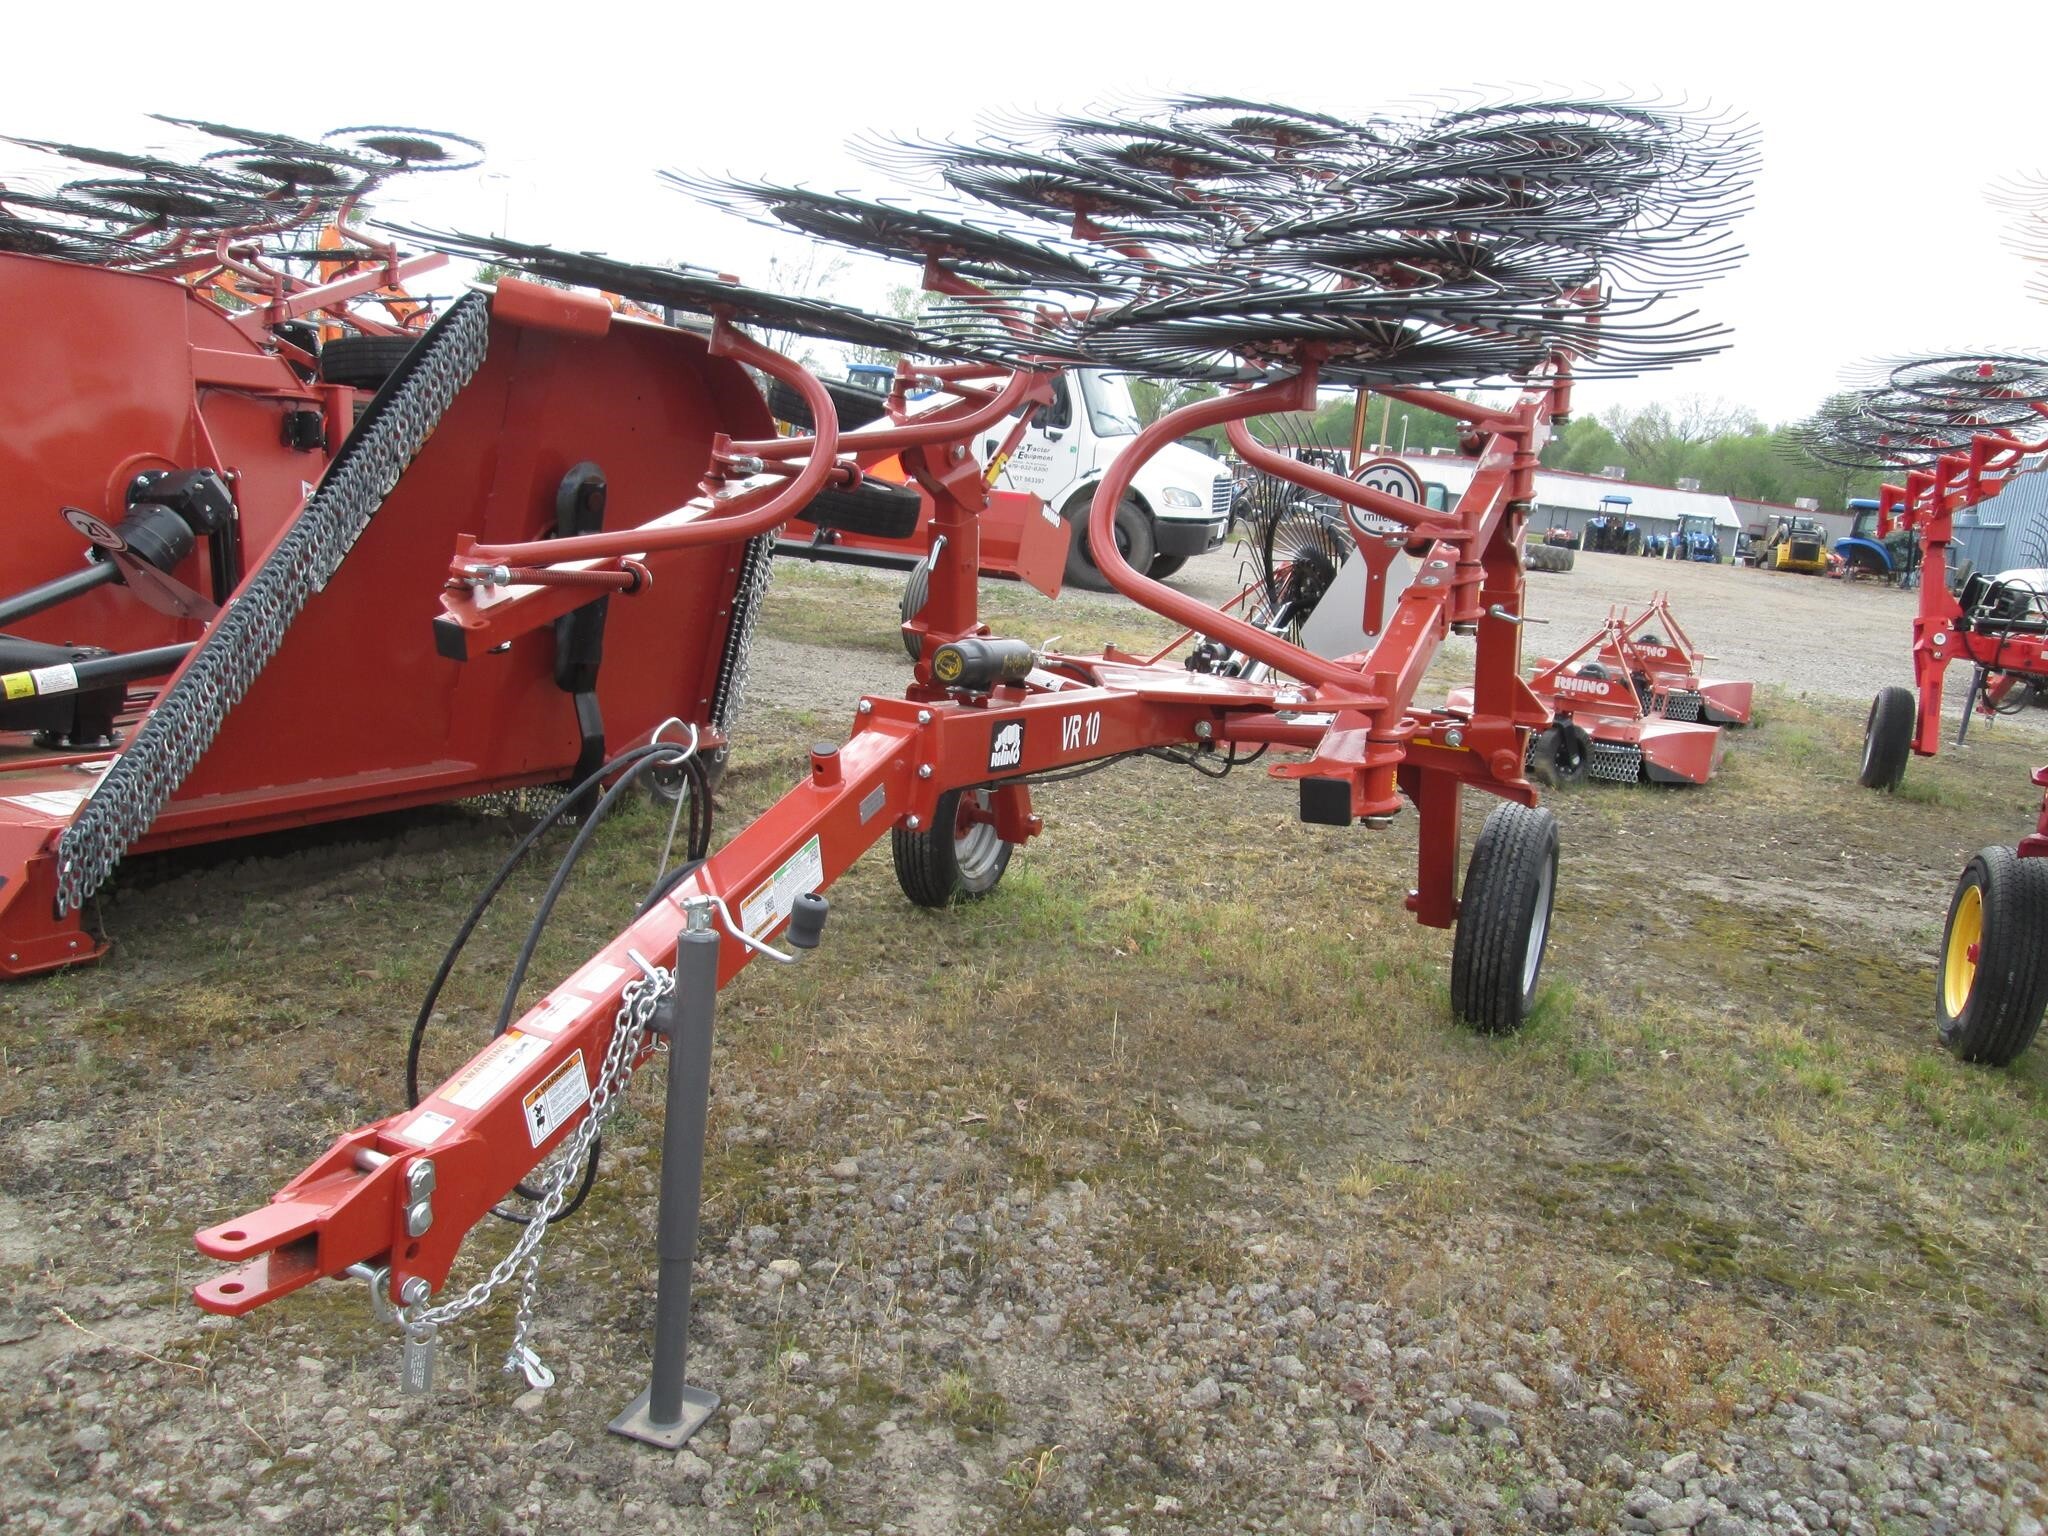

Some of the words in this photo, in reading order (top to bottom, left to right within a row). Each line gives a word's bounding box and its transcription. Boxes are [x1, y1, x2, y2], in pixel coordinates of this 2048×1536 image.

[1017, 451, 1054, 462] Equipment
[1026, 443, 1050, 453] Tractor
[76, 520, 112, 538] 20
[1554, 676, 1610, 695] RHINO
[1062, 714, 1082, 751] VR
[1085, 711, 1101, 746] 10
[990, 743, 1020, 768] RHINO
[467, 1043, 510, 1084] WARNING
[540, 1060, 573, 1092] WARNING
